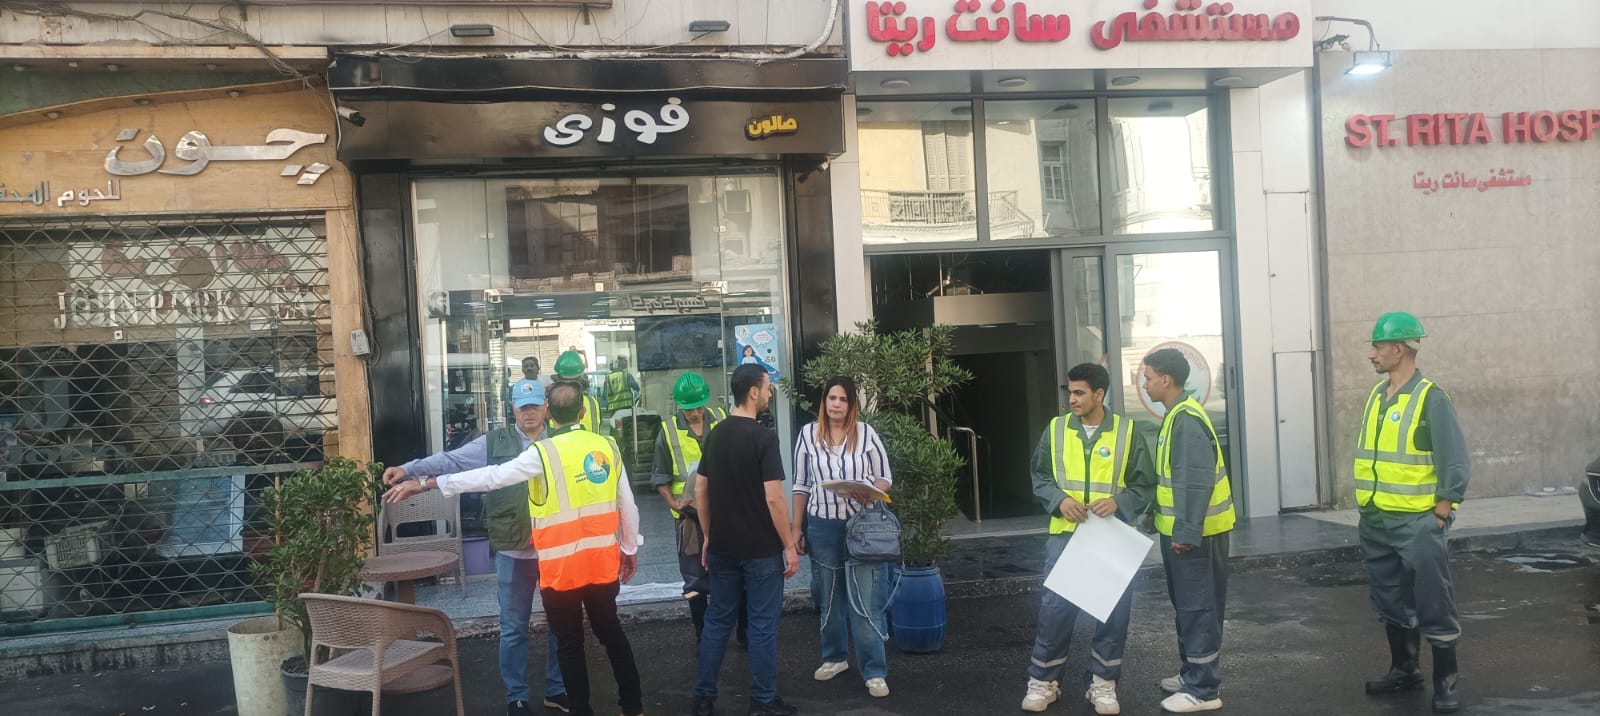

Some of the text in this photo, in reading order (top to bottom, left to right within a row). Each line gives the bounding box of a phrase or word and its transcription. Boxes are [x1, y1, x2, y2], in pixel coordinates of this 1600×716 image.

[865, 0, 1300, 57] مستشفى سانت ريتا
[746, 113, 798, 139] صالون
[1344, 109, 1600, 147] ST. RITA HOSP
[57, 179, 121, 207] للحوم
[1413, 171, 1439, 195] ريتا
[1442, 171, 1478, 190] سانت
